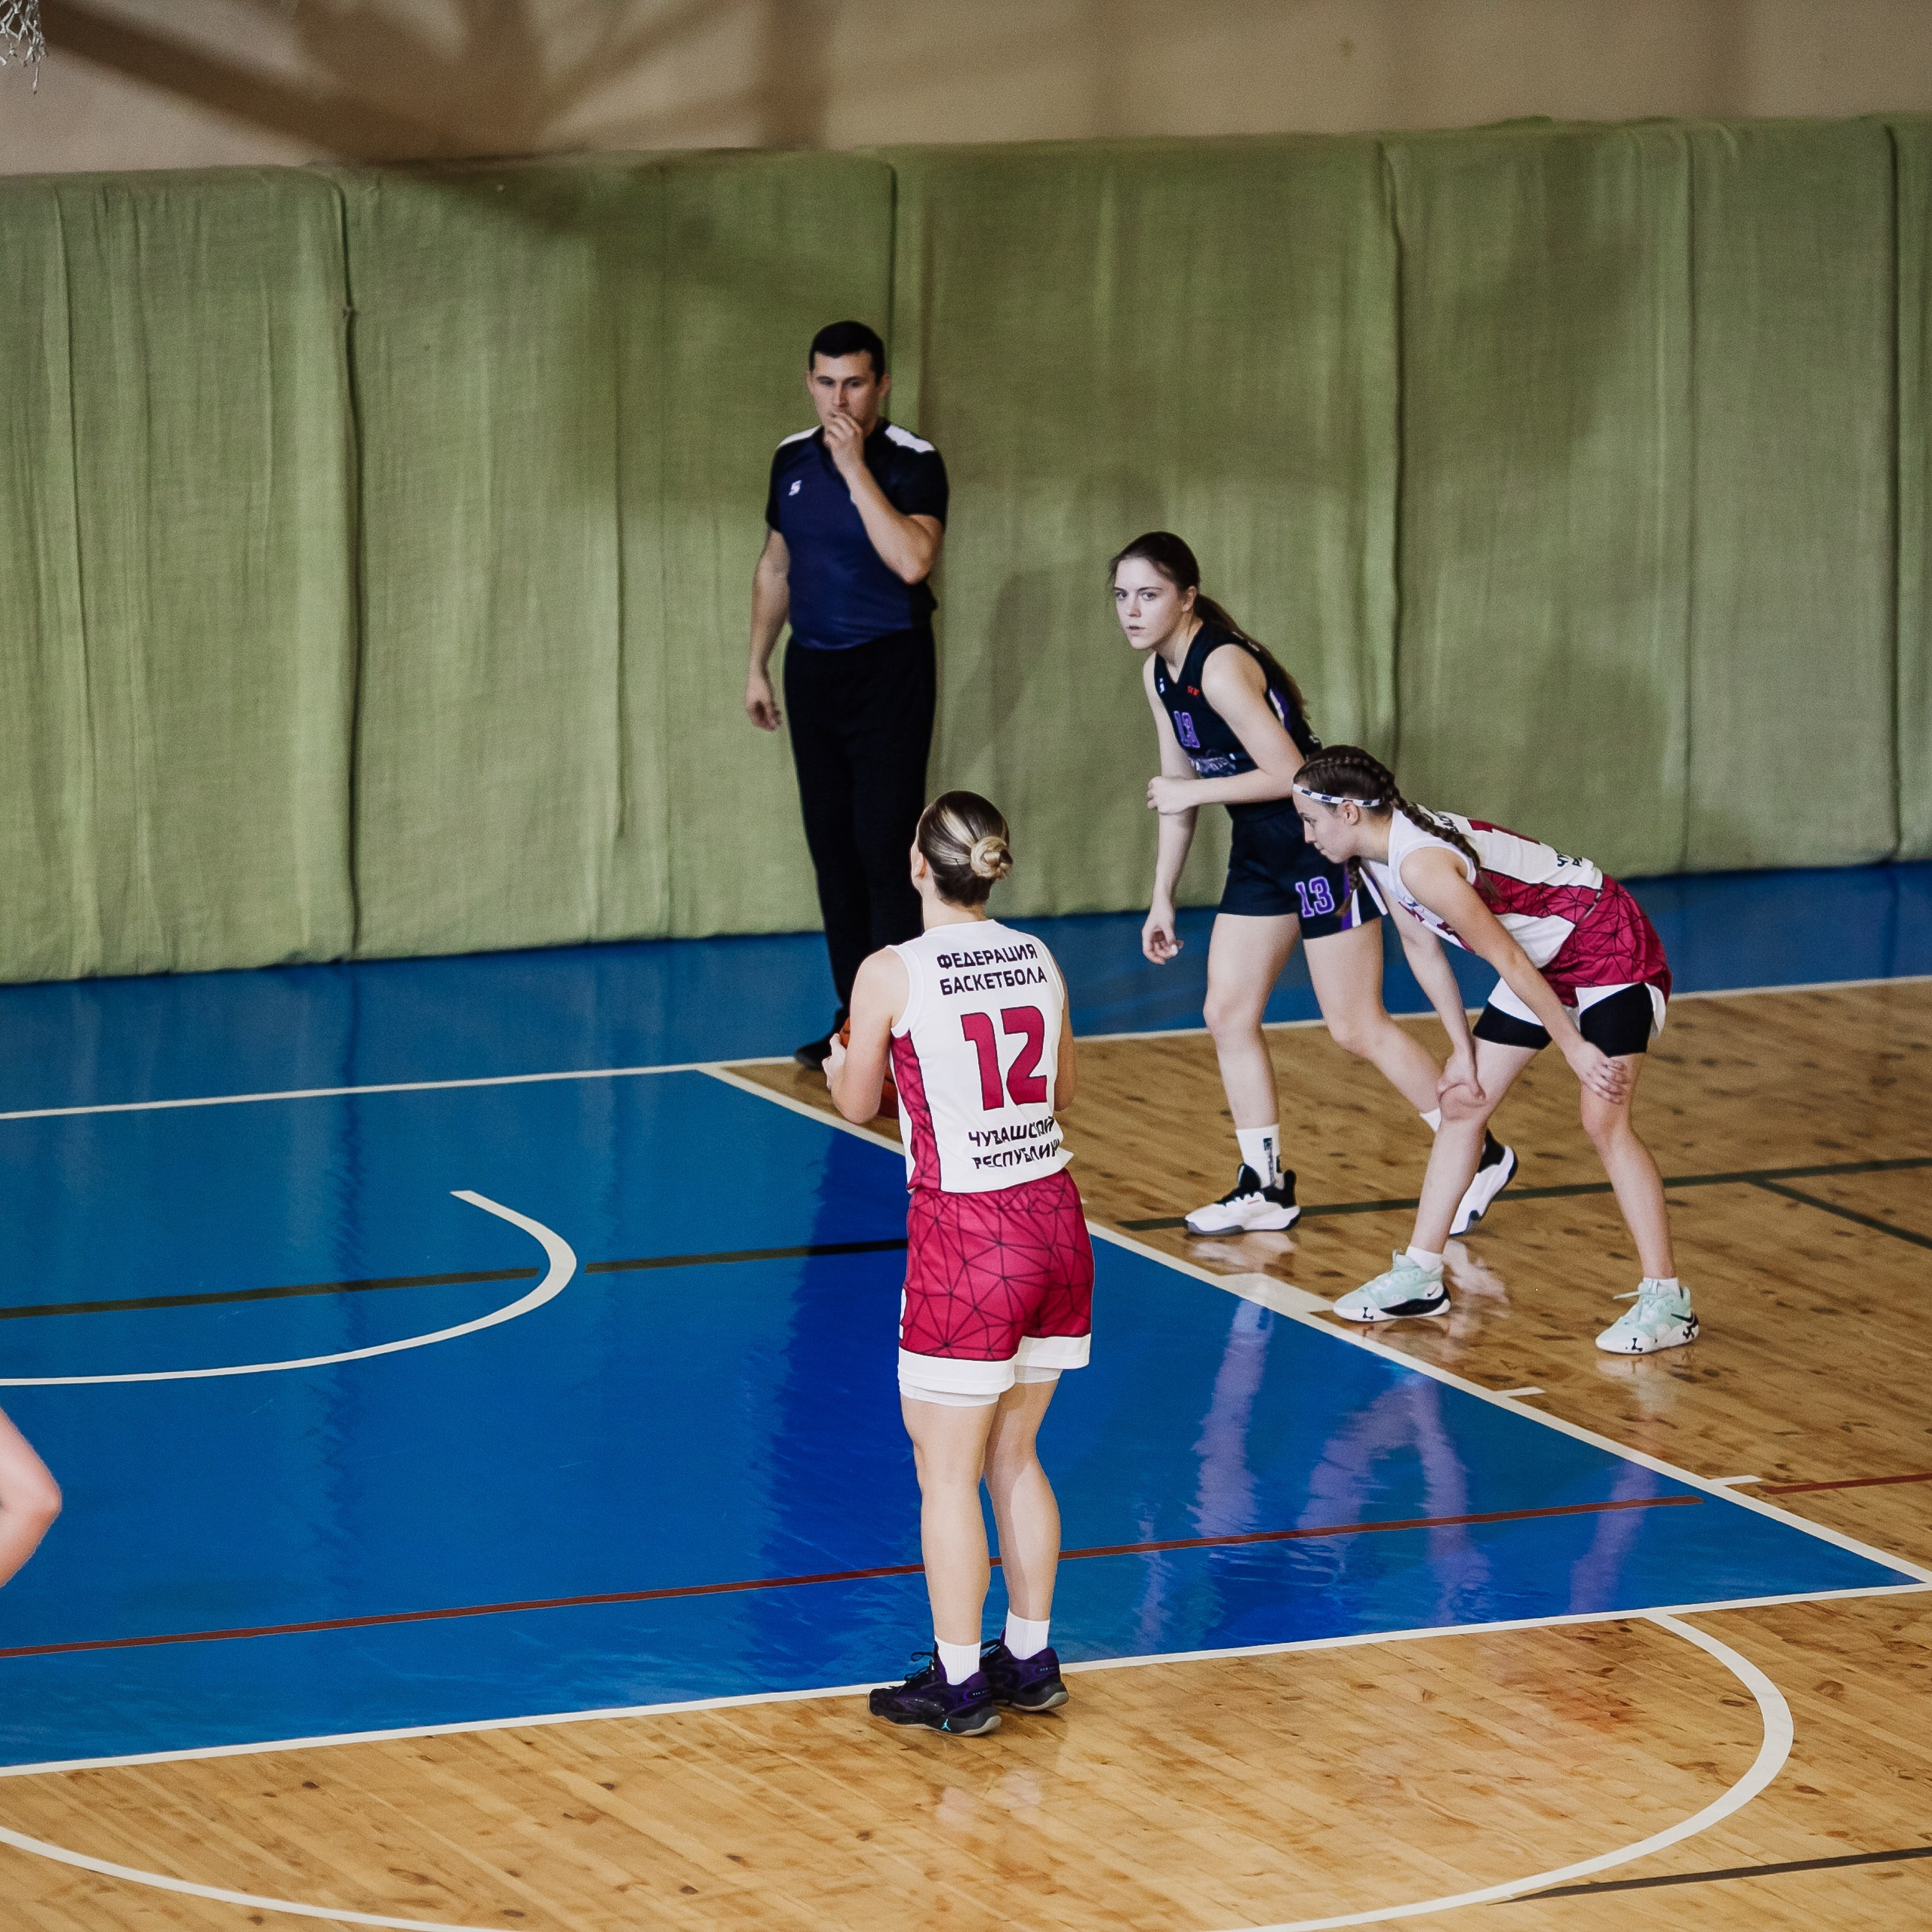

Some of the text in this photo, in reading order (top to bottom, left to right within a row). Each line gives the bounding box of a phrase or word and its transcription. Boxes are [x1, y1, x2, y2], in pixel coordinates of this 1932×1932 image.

[1295, 876, 1335, 918] 13
[937, 943, 1038, 969] ФЕДЕРАЦИЯ
[940, 966, 1048, 995] БАСКЕТБОЛА
[960, 1005, 1048, 1111] 12
